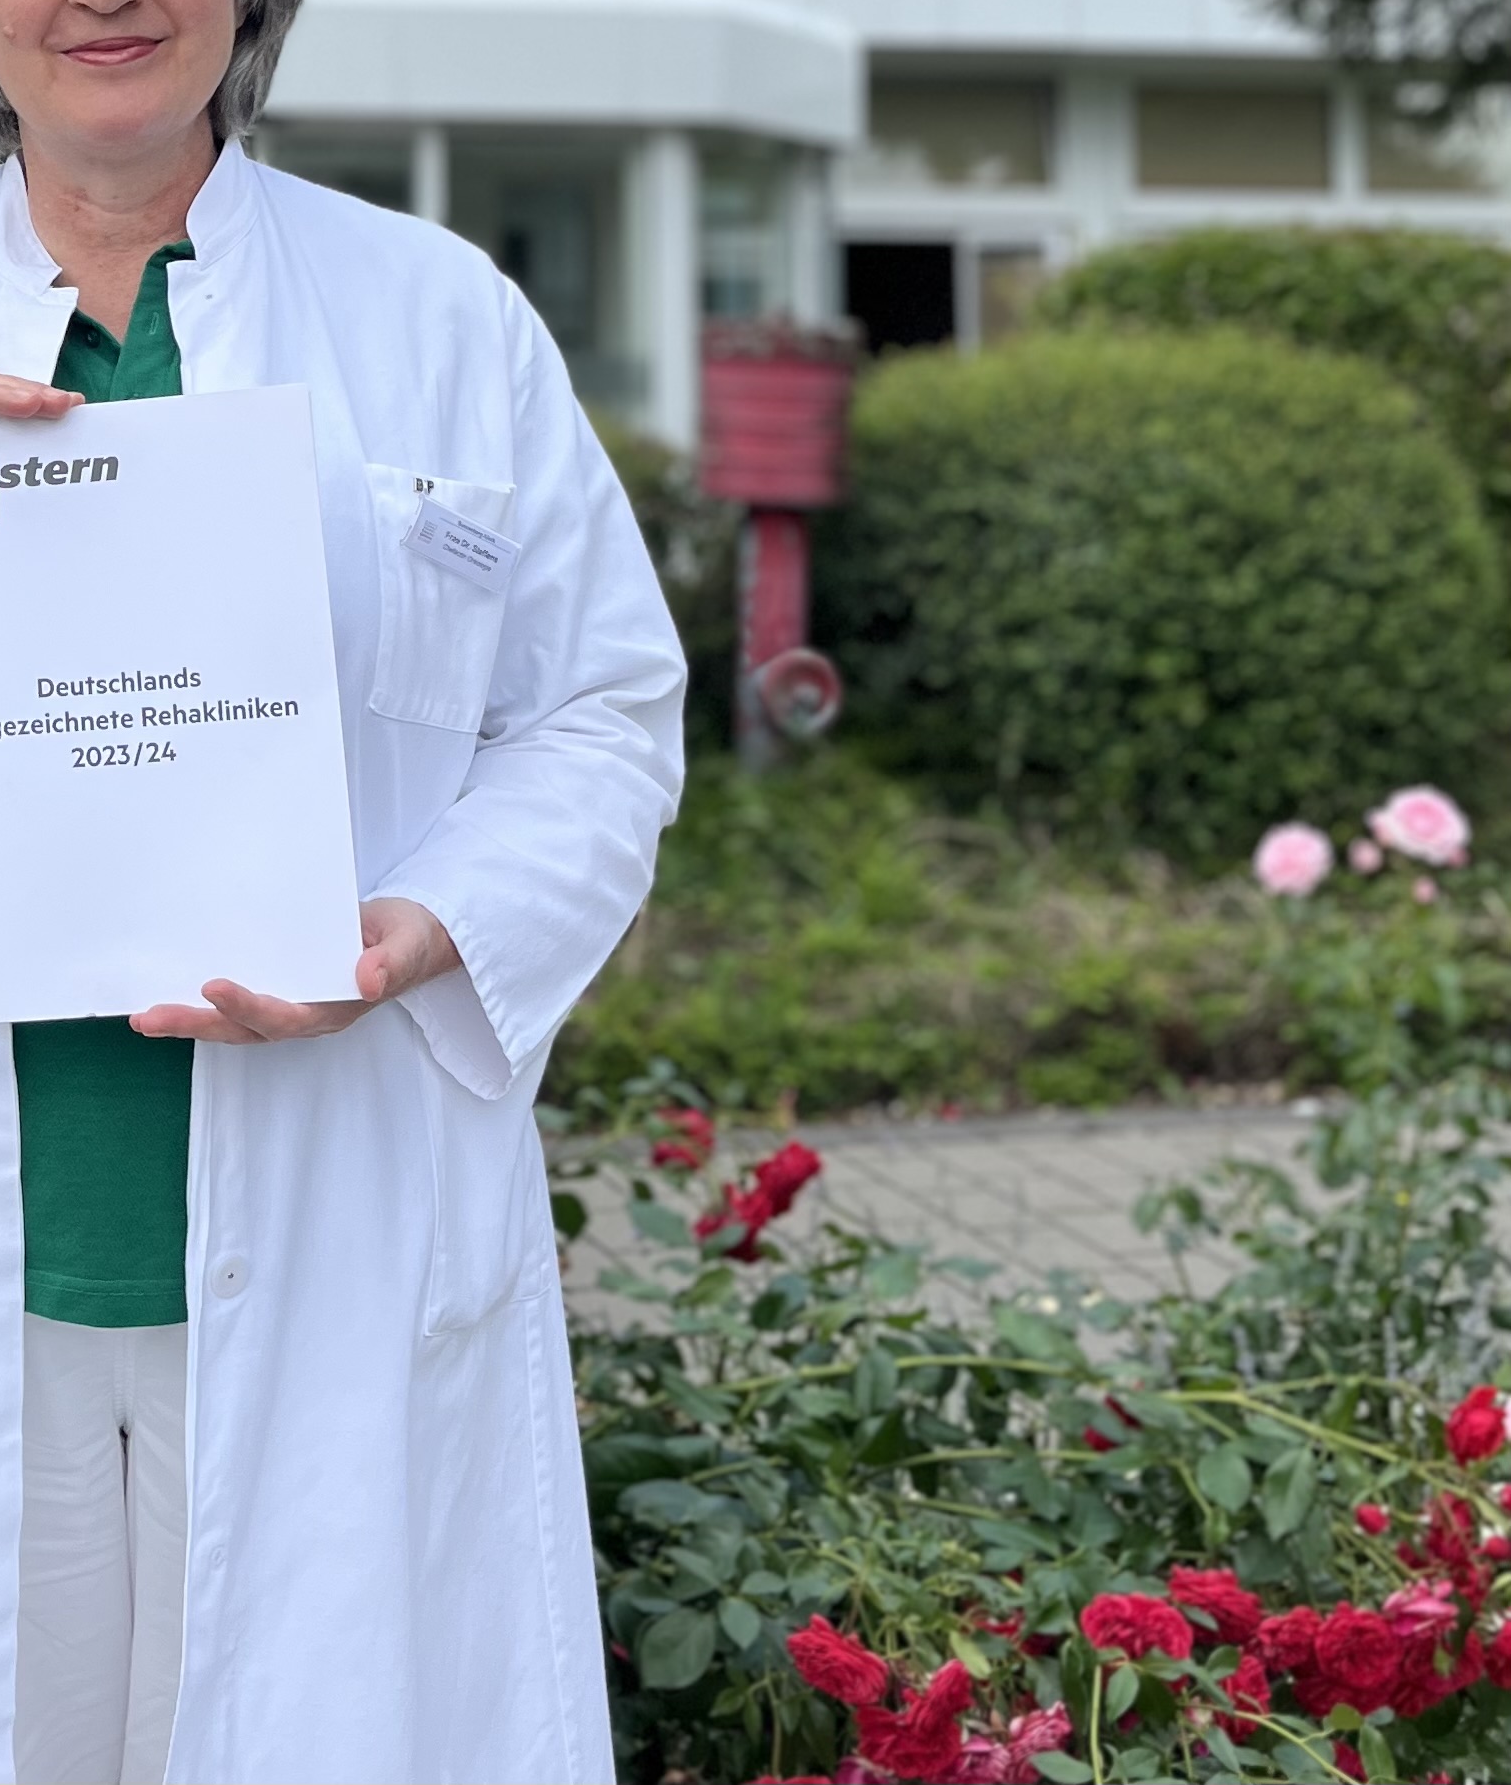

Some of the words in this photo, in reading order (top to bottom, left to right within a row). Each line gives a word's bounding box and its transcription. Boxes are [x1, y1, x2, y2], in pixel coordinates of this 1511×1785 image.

[37, 667, 202, 698] Deutschlands
[142, 698, 299, 727] Rehakliniken
[71, 741, 177, 768] 2023/24
